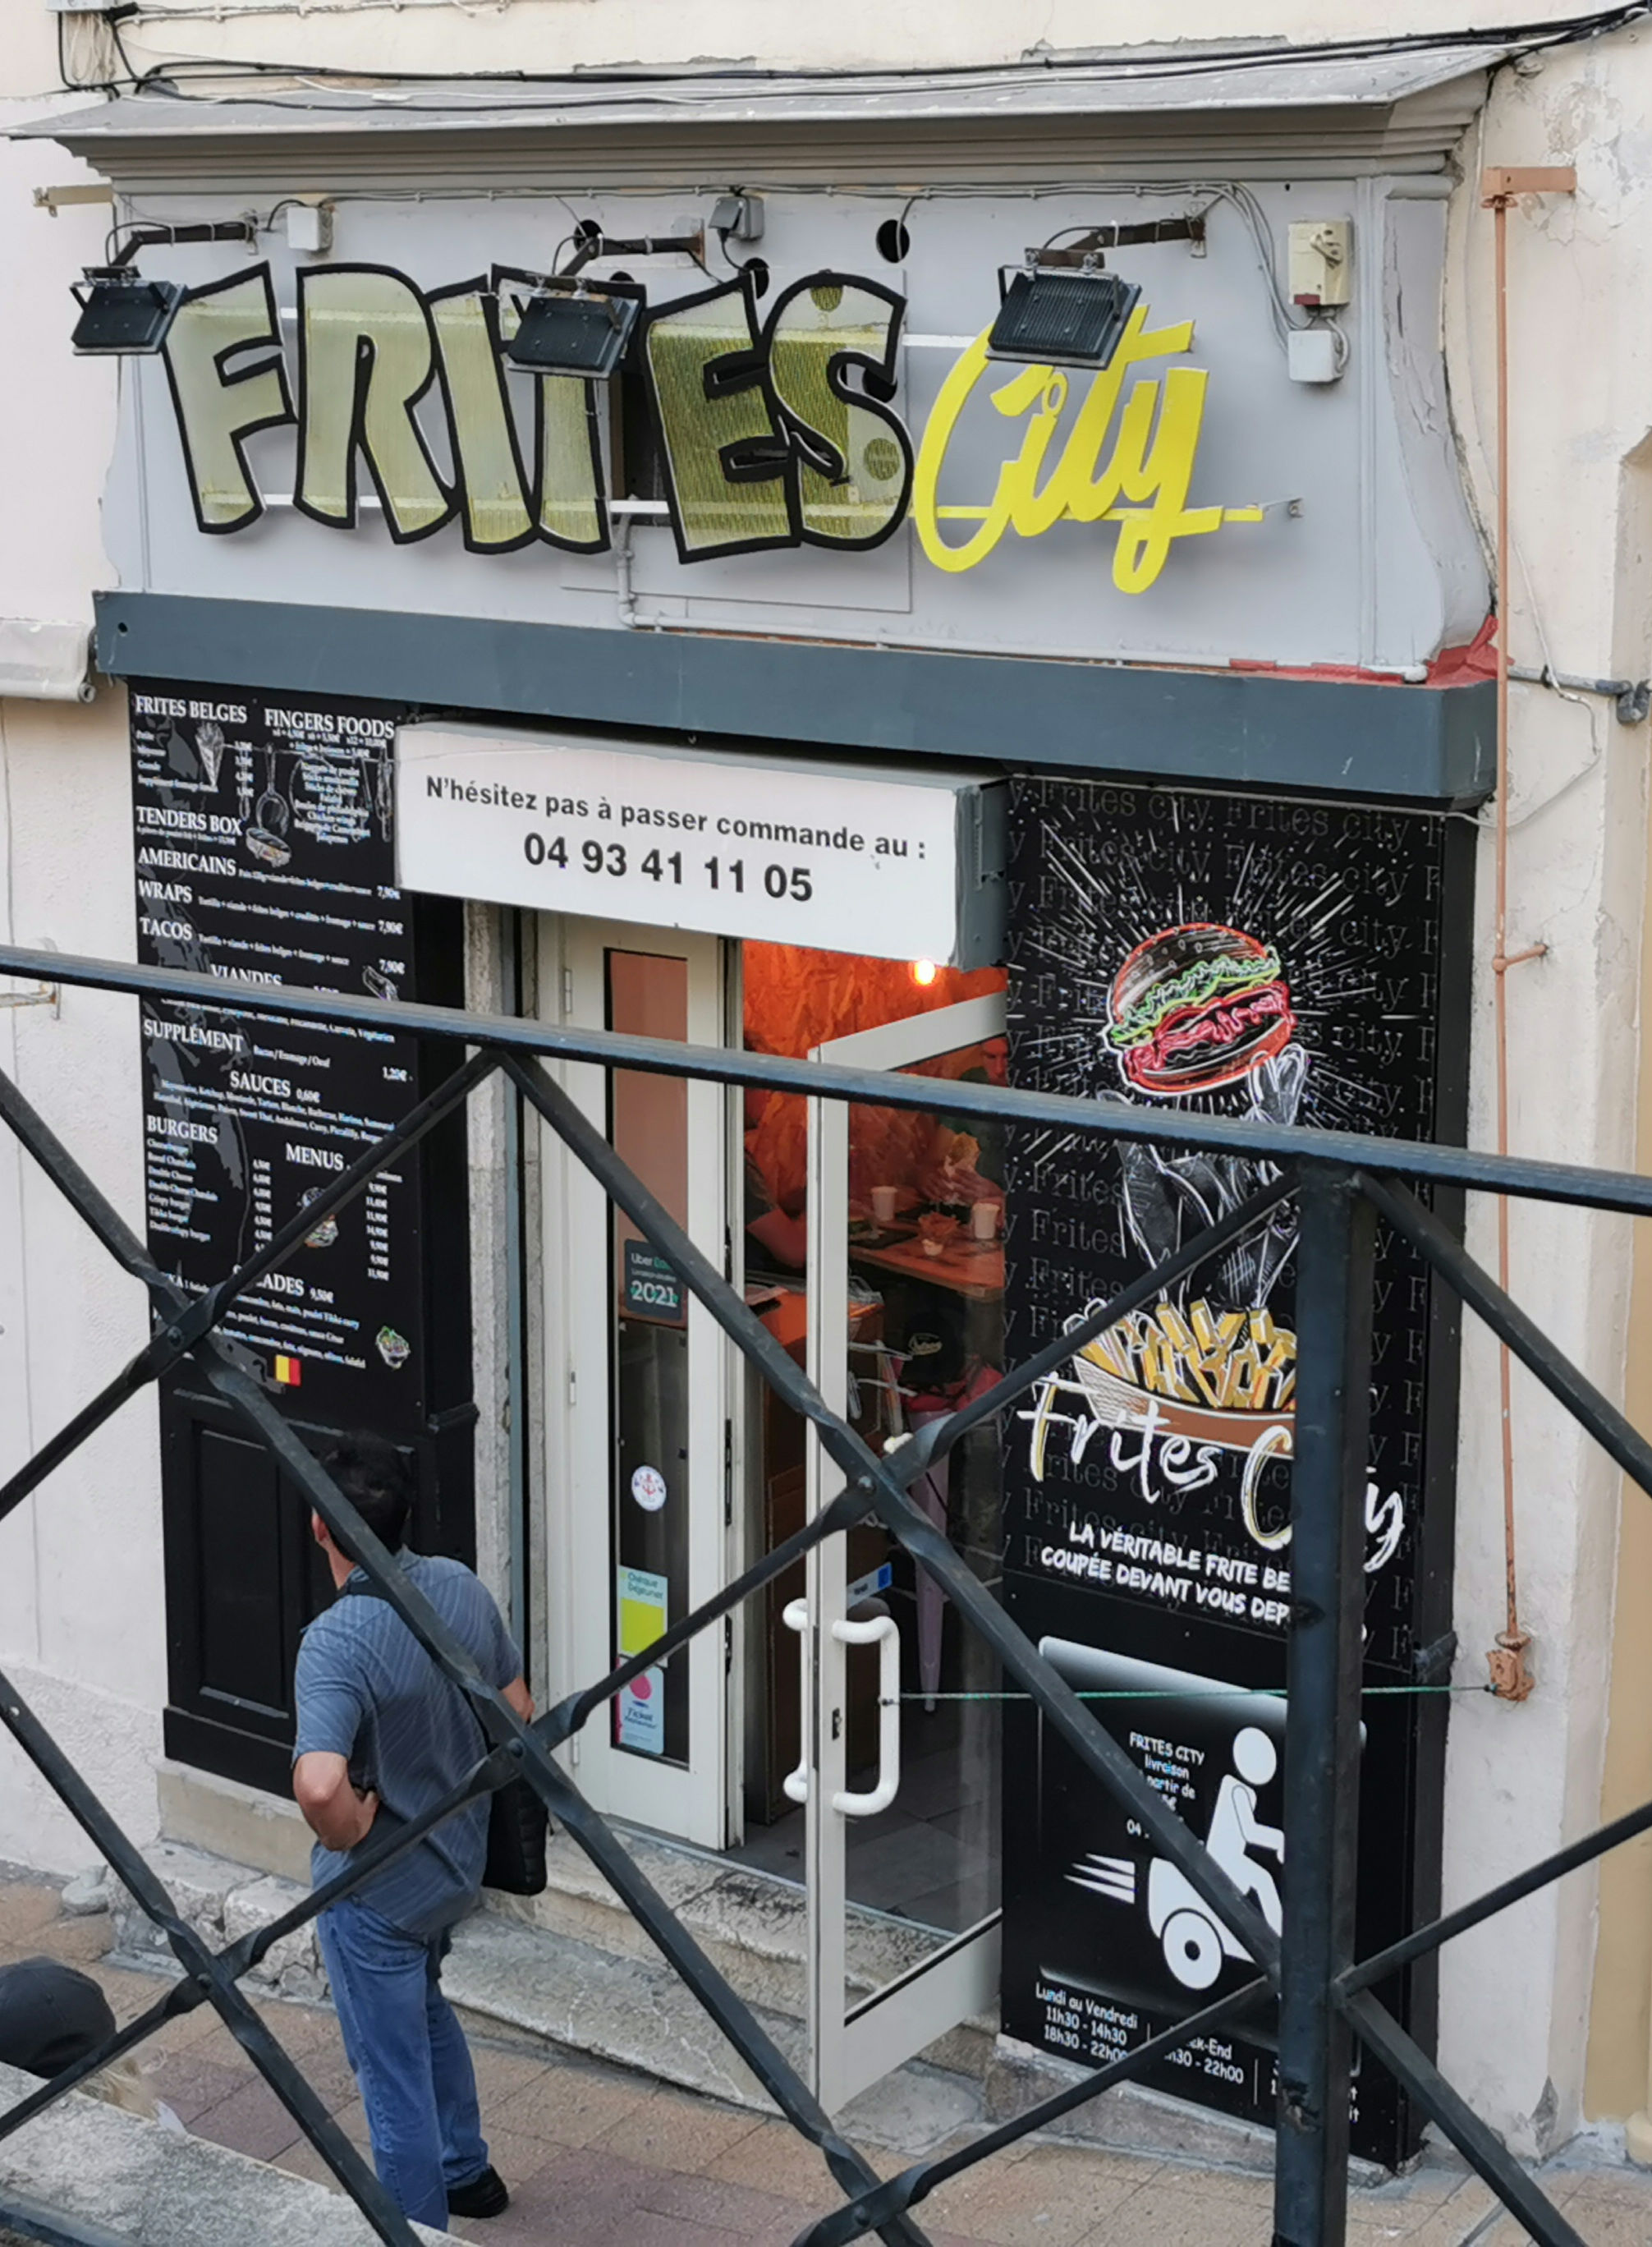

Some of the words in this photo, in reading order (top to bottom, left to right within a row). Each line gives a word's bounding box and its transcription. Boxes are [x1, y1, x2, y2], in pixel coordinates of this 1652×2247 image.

[161, 260, 915, 564] FRITES
[913, 304, 1223, 595] City
[135, 694, 186, 717] FRITES
[189, 701, 248, 724] BELGES
[264, 708, 334, 733] FINGERS
[337, 715, 394, 739] FOODS
[136, 806, 207, 831] TENDERS
[209, 815, 243, 836] BOX
[426, 775, 538, 811] N'hésitez
[545, 795, 590, 818] pas
[598, 797, 613, 820] à
[622, 803, 708, 832] passer
[717, 816, 865, 852] commande
[874, 836, 909, 857] au
[138, 847, 236, 877] AMERICAINS
[524, 832, 568, 867] 04
[581, 839, 627, 877] 93
[640, 848, 683, 885] 41
[704, 856, 744, 894] 11
[764, 863, 813, 902] 05
[138, 879, 193, 903] WRAPS
[139, 917, 193, 941] TACOS
[230, 1069, 291, 1098] SAUCES
[146, 1114, 218, 1144] BURGERS
[286, 1142, 344, 1170] MENUS
[631, 1280, 678, 1308] 2021
[1016, 1371, 1223, 1505] Frites
[1069, 1520, 1094, 1550] LA
[1099, 1525, 1201, 1571] VÉRITABLE
[1205, 1553, 1259, 1585] FRITE
[1040, 1545, 1112, 1580] COUPÉE
[1115, 1565, 1192, 1601] DEVANT
[1195, 1582, 1246, 1615] VOUS
[1129, 1730, 1174, 1758] FRITES
[1175, 1745, 1205, 1765] CITY
[1144, 1753, 1190, 1781] livraison
[1182, 1783, 1196, 1800] de
[1035, 1981, 1067, 2006] Lundi
[1068, 1996, 1083, 2012] au
[1085, 1997, 1139, 2030] Vendredi
[1044, 2024, 1080, 2050] 18h30
[1045, 2006, 1080, 2031] 11h30
[1090, 2020, 1127, 2046] 14h30
[1204, 2057, 1244, 2084] 22h00
